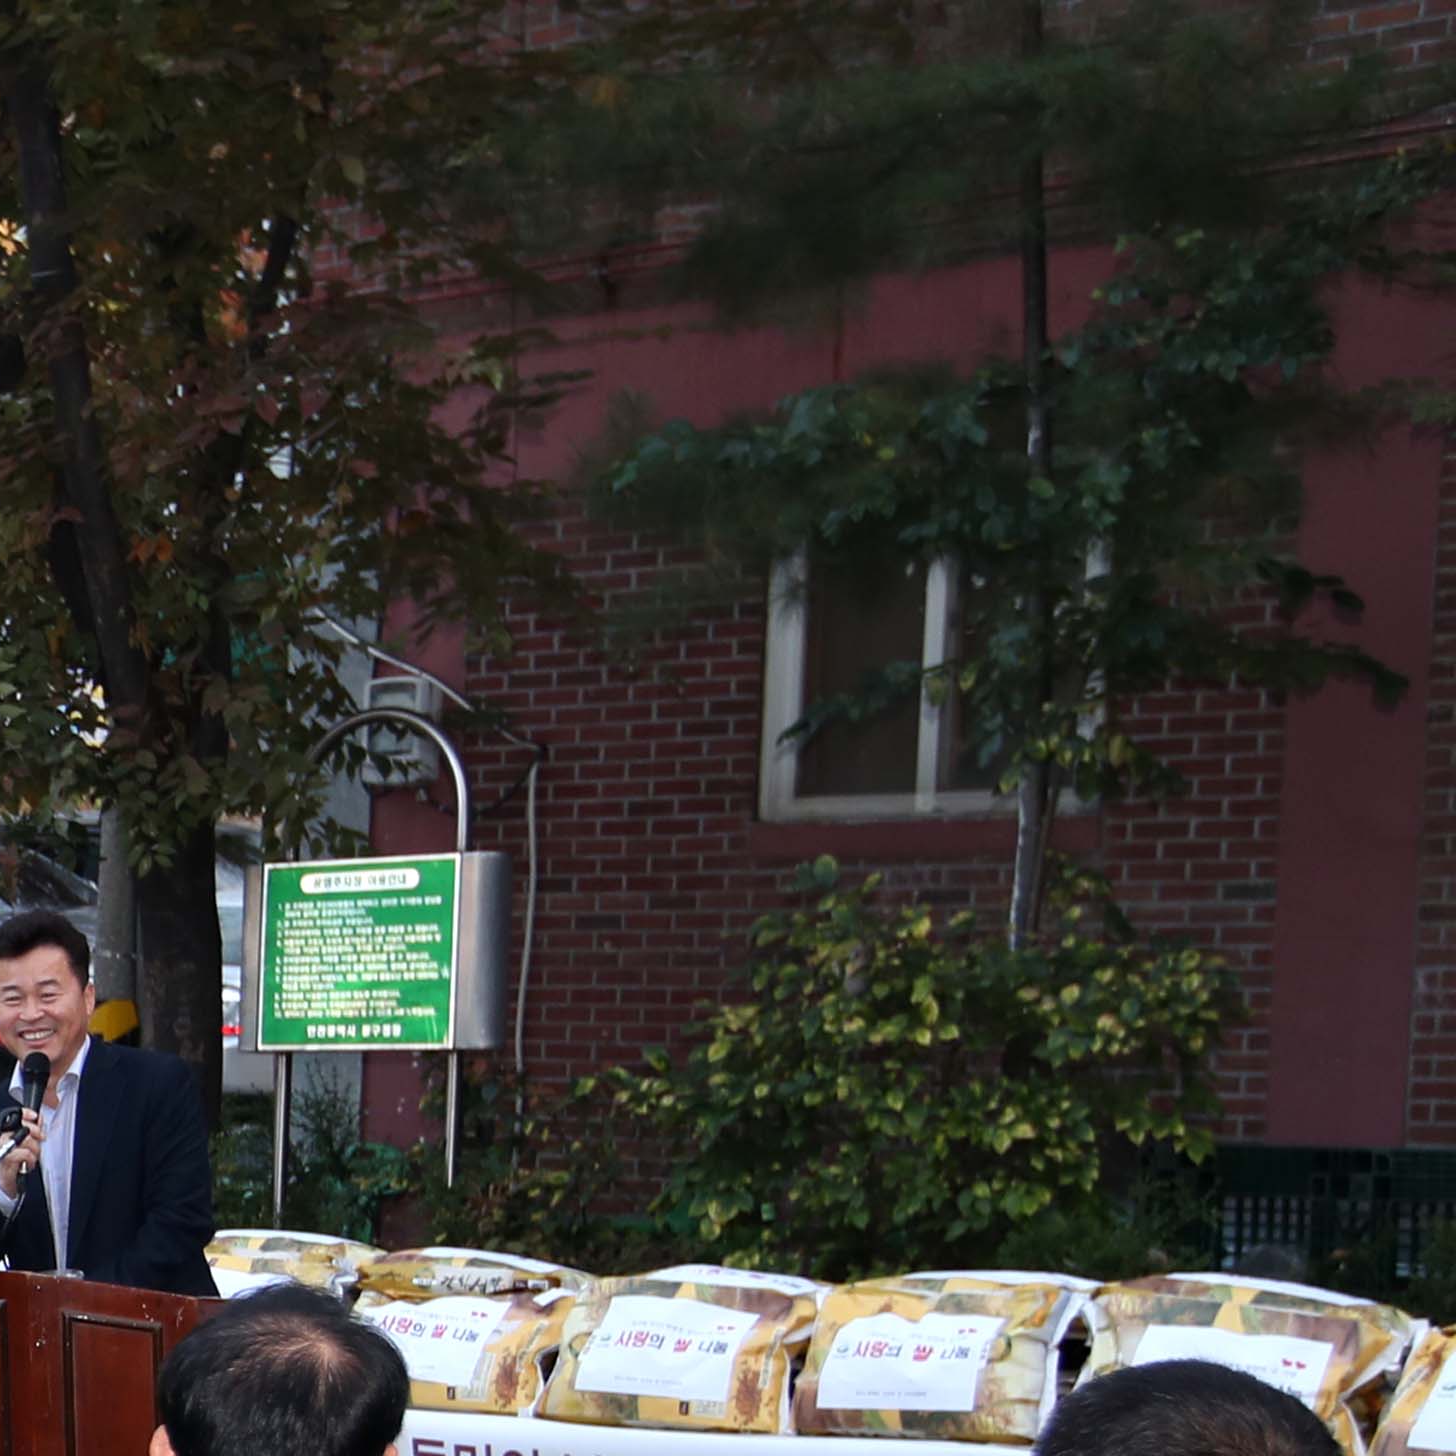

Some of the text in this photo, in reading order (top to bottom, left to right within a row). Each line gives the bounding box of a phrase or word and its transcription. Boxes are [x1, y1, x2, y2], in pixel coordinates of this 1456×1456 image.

[379, 1314, 480, 1342] 사랑의 쌀 나눔
[614, 1329, 729, 1355] 사랑의 쌀 나눔
[851, 1340, 903, 1359] 사랑의
